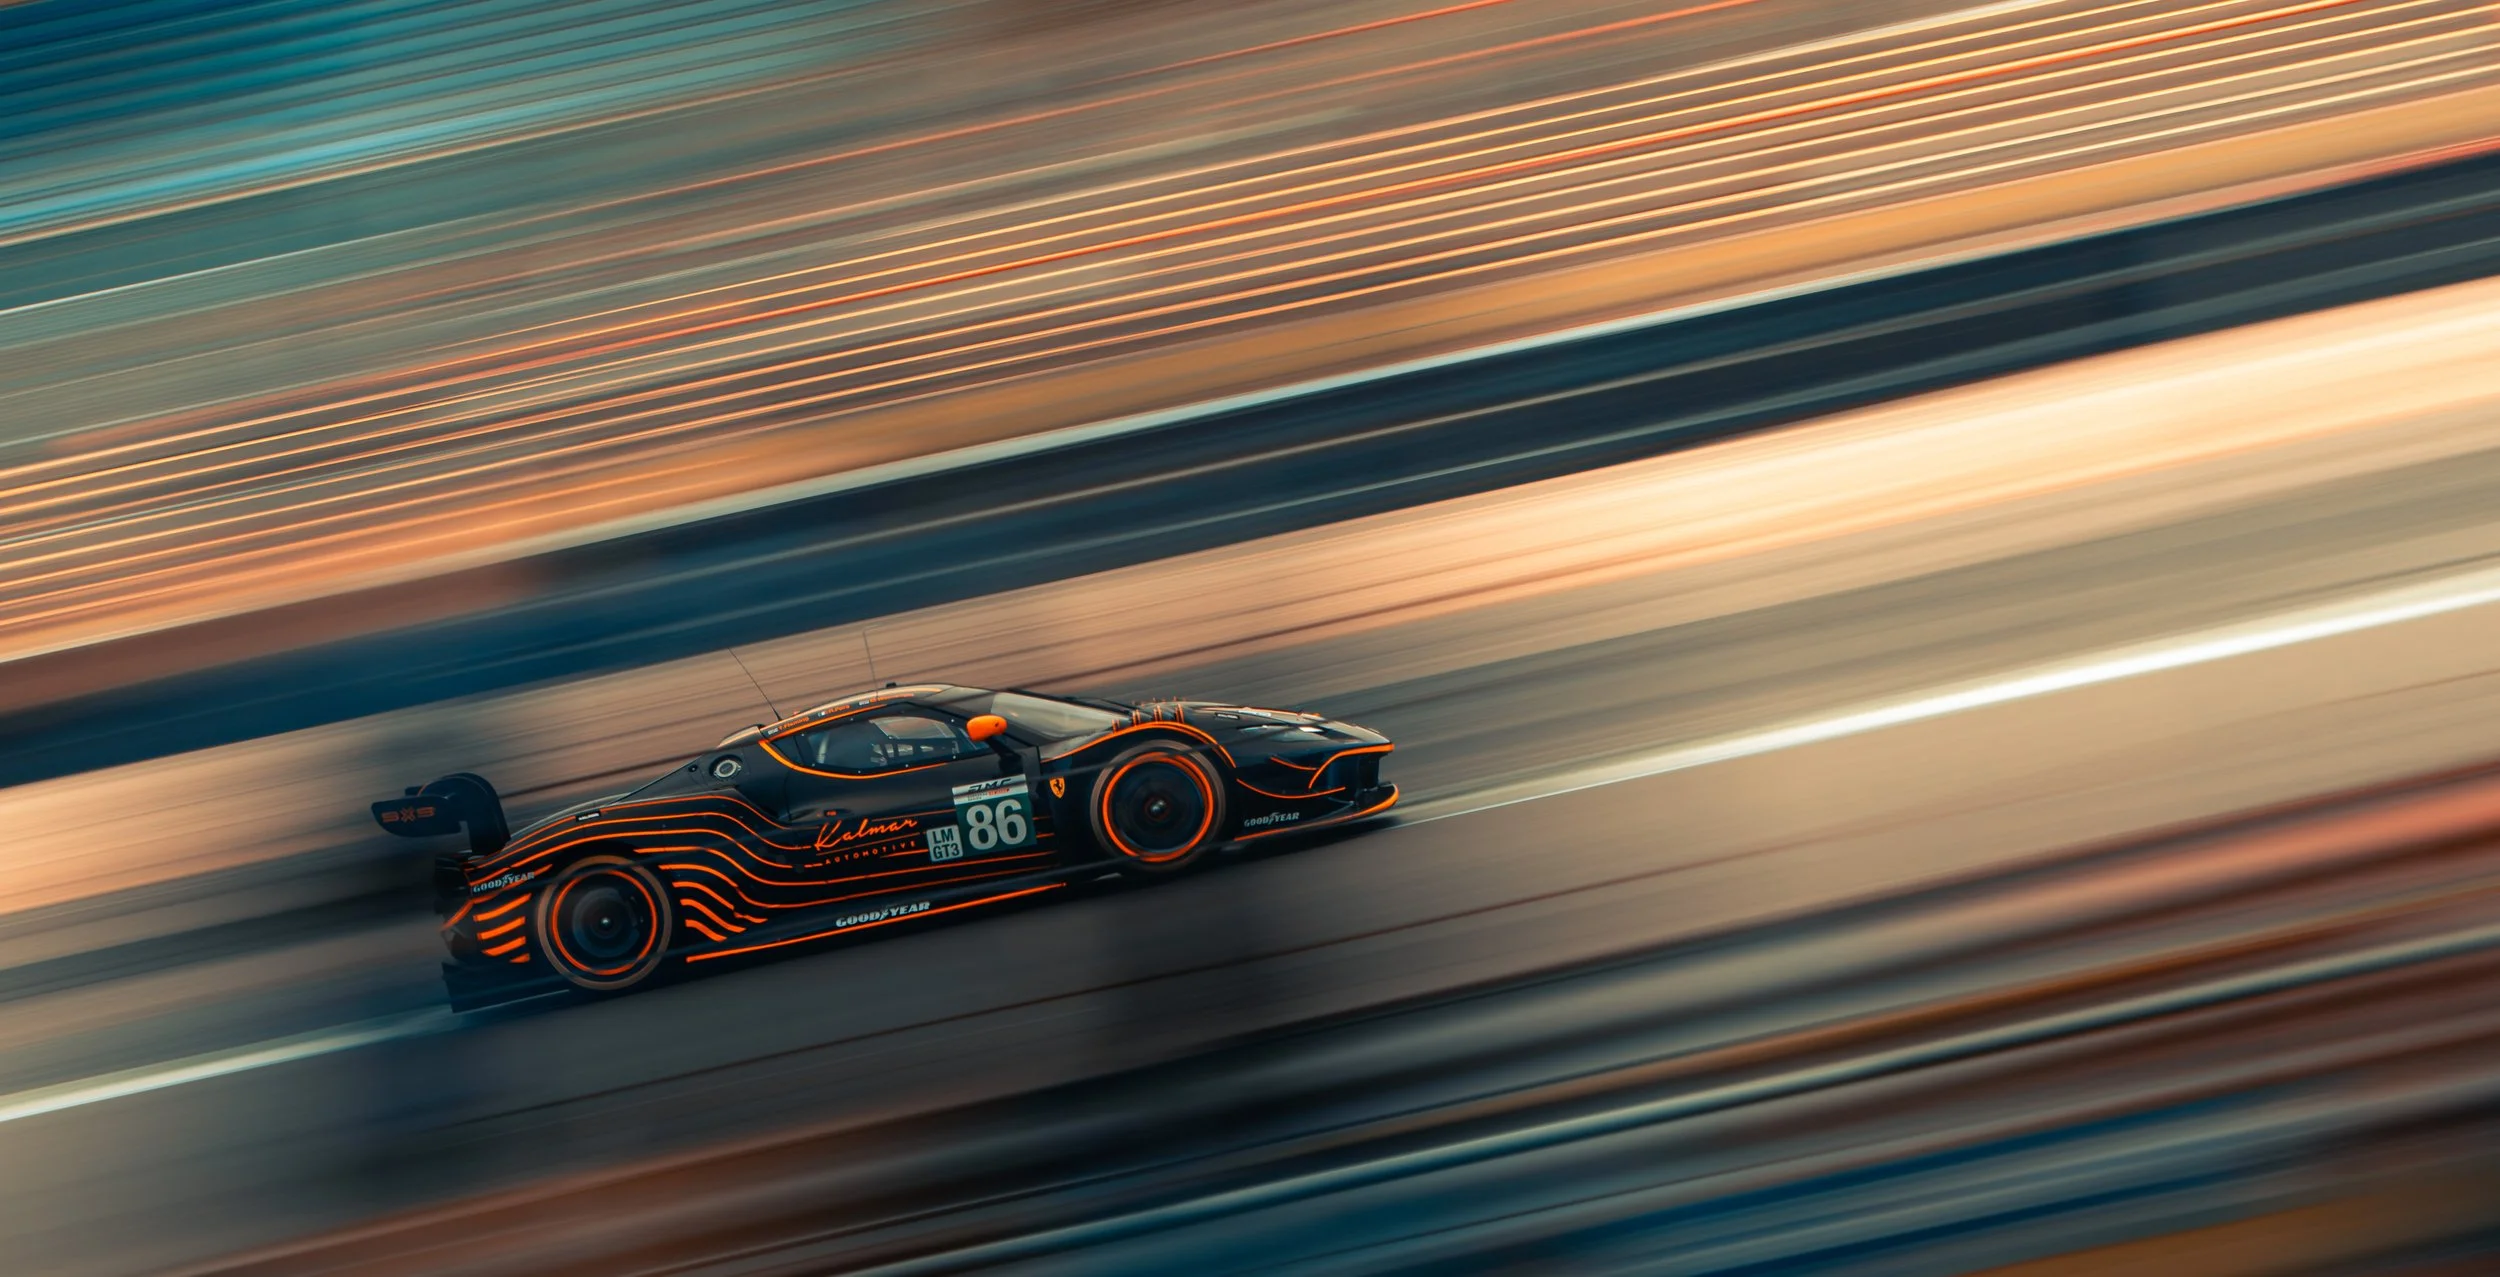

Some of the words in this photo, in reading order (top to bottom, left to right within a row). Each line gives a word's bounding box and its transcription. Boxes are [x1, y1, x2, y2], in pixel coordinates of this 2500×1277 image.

[966, 799, 1027, 850] 86
[1244, 812, 1300, 827] GOODYEAR
[814, 818, 918, 851] Kalmar
[932, 828, 954, 844] LM
[825, 840, 916, 865] AUTOMOTIVE
[933, 843, 960, 860] GT3
[836, 901, 931, 927] GOODYEAR
